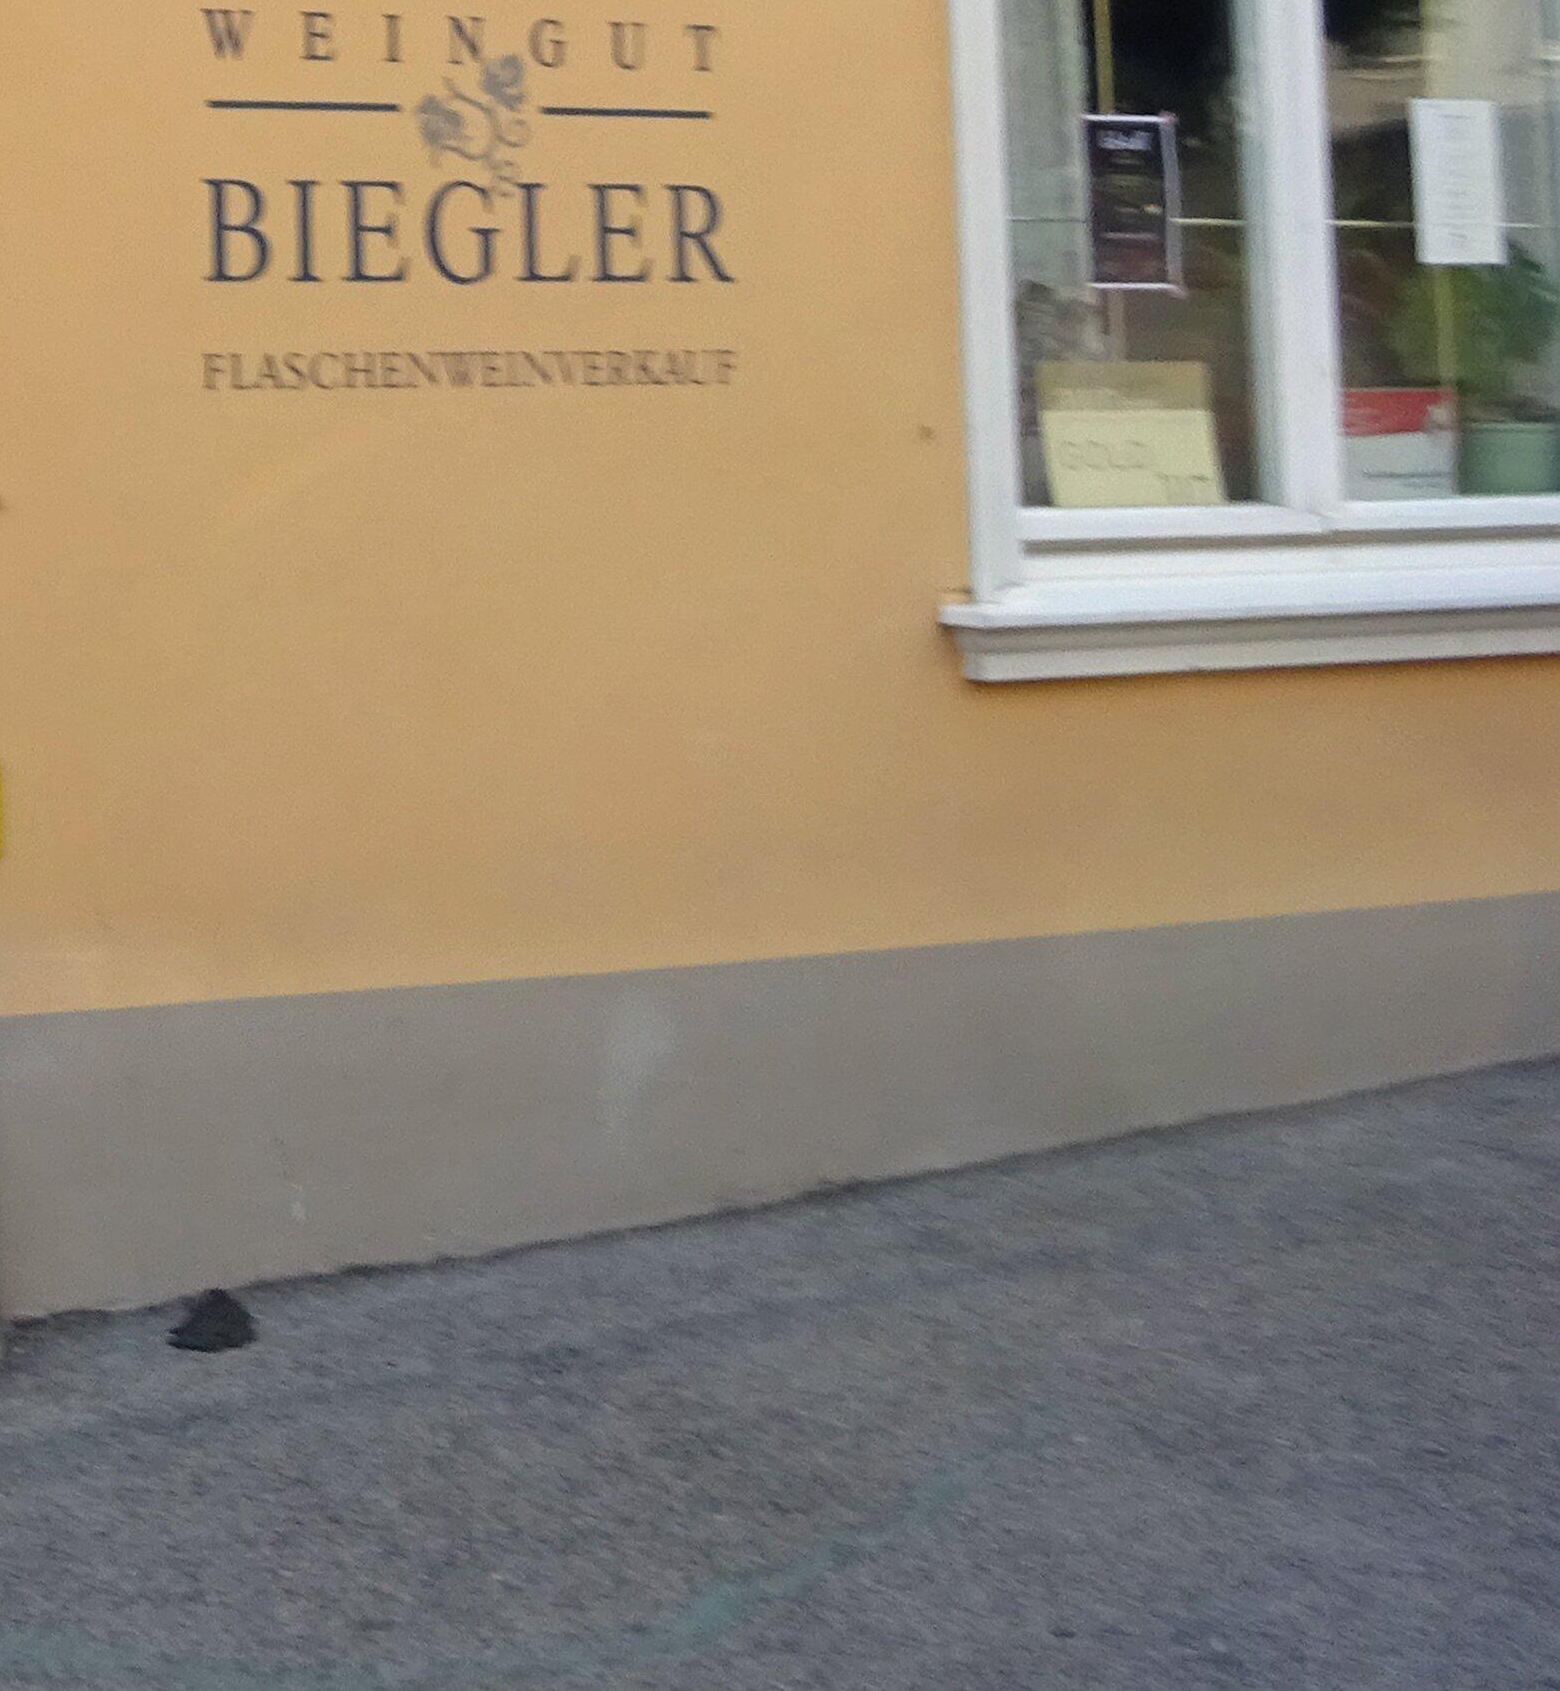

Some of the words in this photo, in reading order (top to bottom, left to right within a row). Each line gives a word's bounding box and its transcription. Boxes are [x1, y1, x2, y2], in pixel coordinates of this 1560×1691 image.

[200, 8, 719, 72] WEINGUT
[201, 178, 737, 286] BIEGLER
[201, 350, 739, 391] FLASCHENWEINVERKAUF
